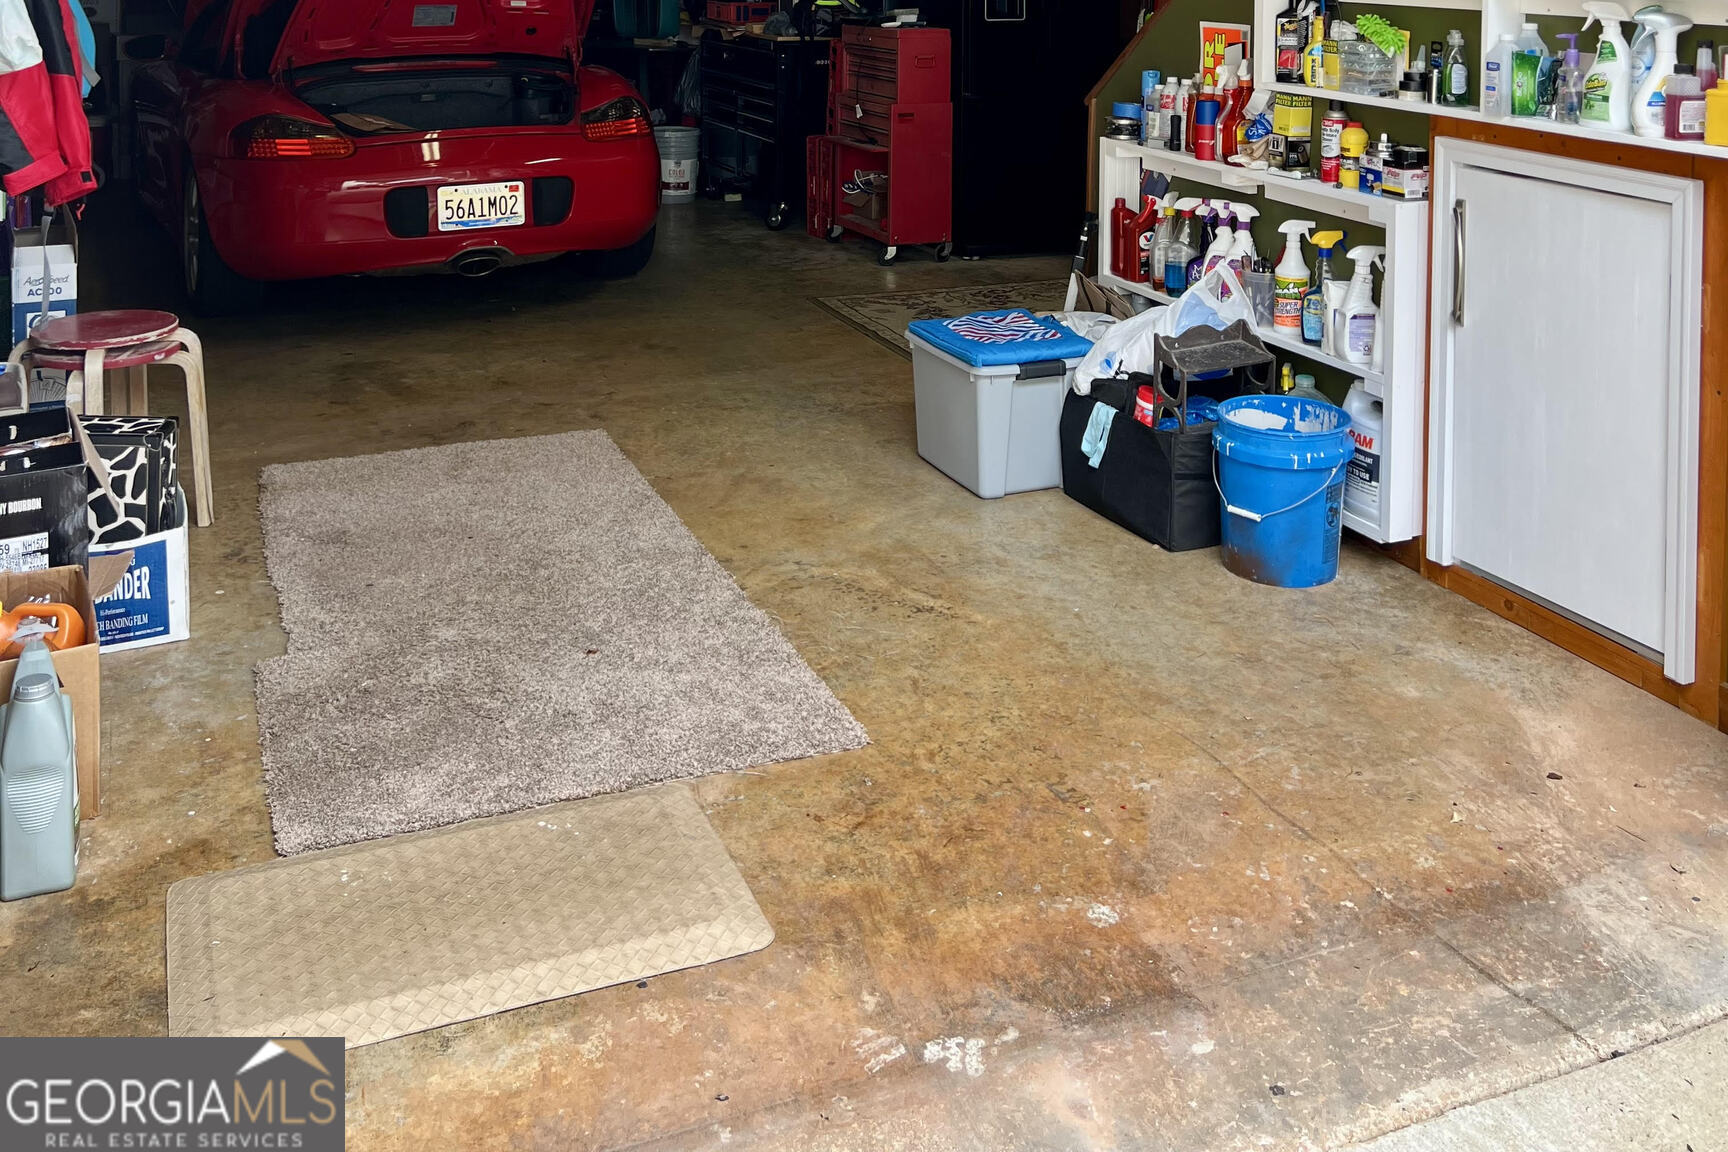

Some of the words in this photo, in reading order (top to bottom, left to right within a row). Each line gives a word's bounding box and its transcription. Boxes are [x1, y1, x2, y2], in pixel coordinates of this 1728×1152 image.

[444, 194, 519, 221] 56A1M02
[8, 497, 42, 514] BOURBON
[105, 616, 133, 630] BANDING
[133, 613, 149, 625] FILM
